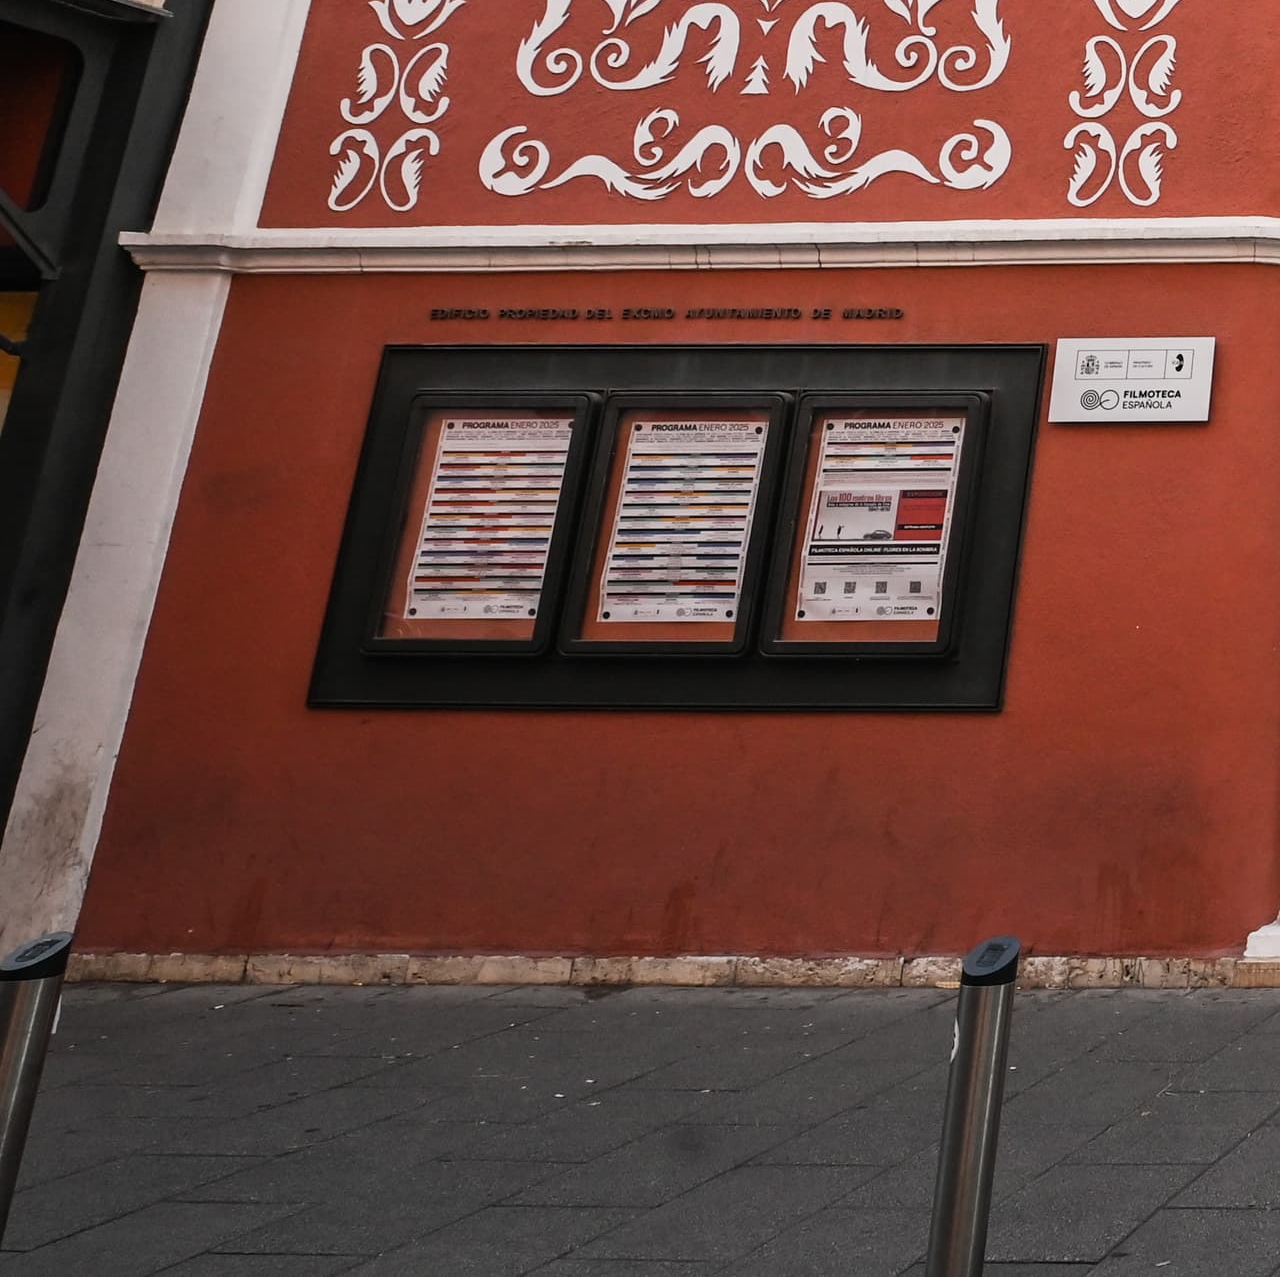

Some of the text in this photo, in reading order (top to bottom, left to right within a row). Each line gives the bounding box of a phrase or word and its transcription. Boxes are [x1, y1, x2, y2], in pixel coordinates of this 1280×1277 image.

[430, 308, 490, 320] EDIFICIO
[498, 308, 579, 320] PROPIEDAD
[585, 308, 613, 319] DEL
[685, 307, 802, 320] AYUNTAMIENTO
[811, 307, 832, 319] DE
[842, 307, 904, 319] MADRID
[1123, 390, 1181, 399] FILMOTECA
[1122, 399, 1172, 409] ESPAÑOLA
[462, 421, 560, 430] PROGRAMA ENERO 2025
[698, 423, 727, 431] ENERO
[728, 423, 749, 431] 2025
[844, 421, 944, 430] PROGRAMA ENERO 2025
